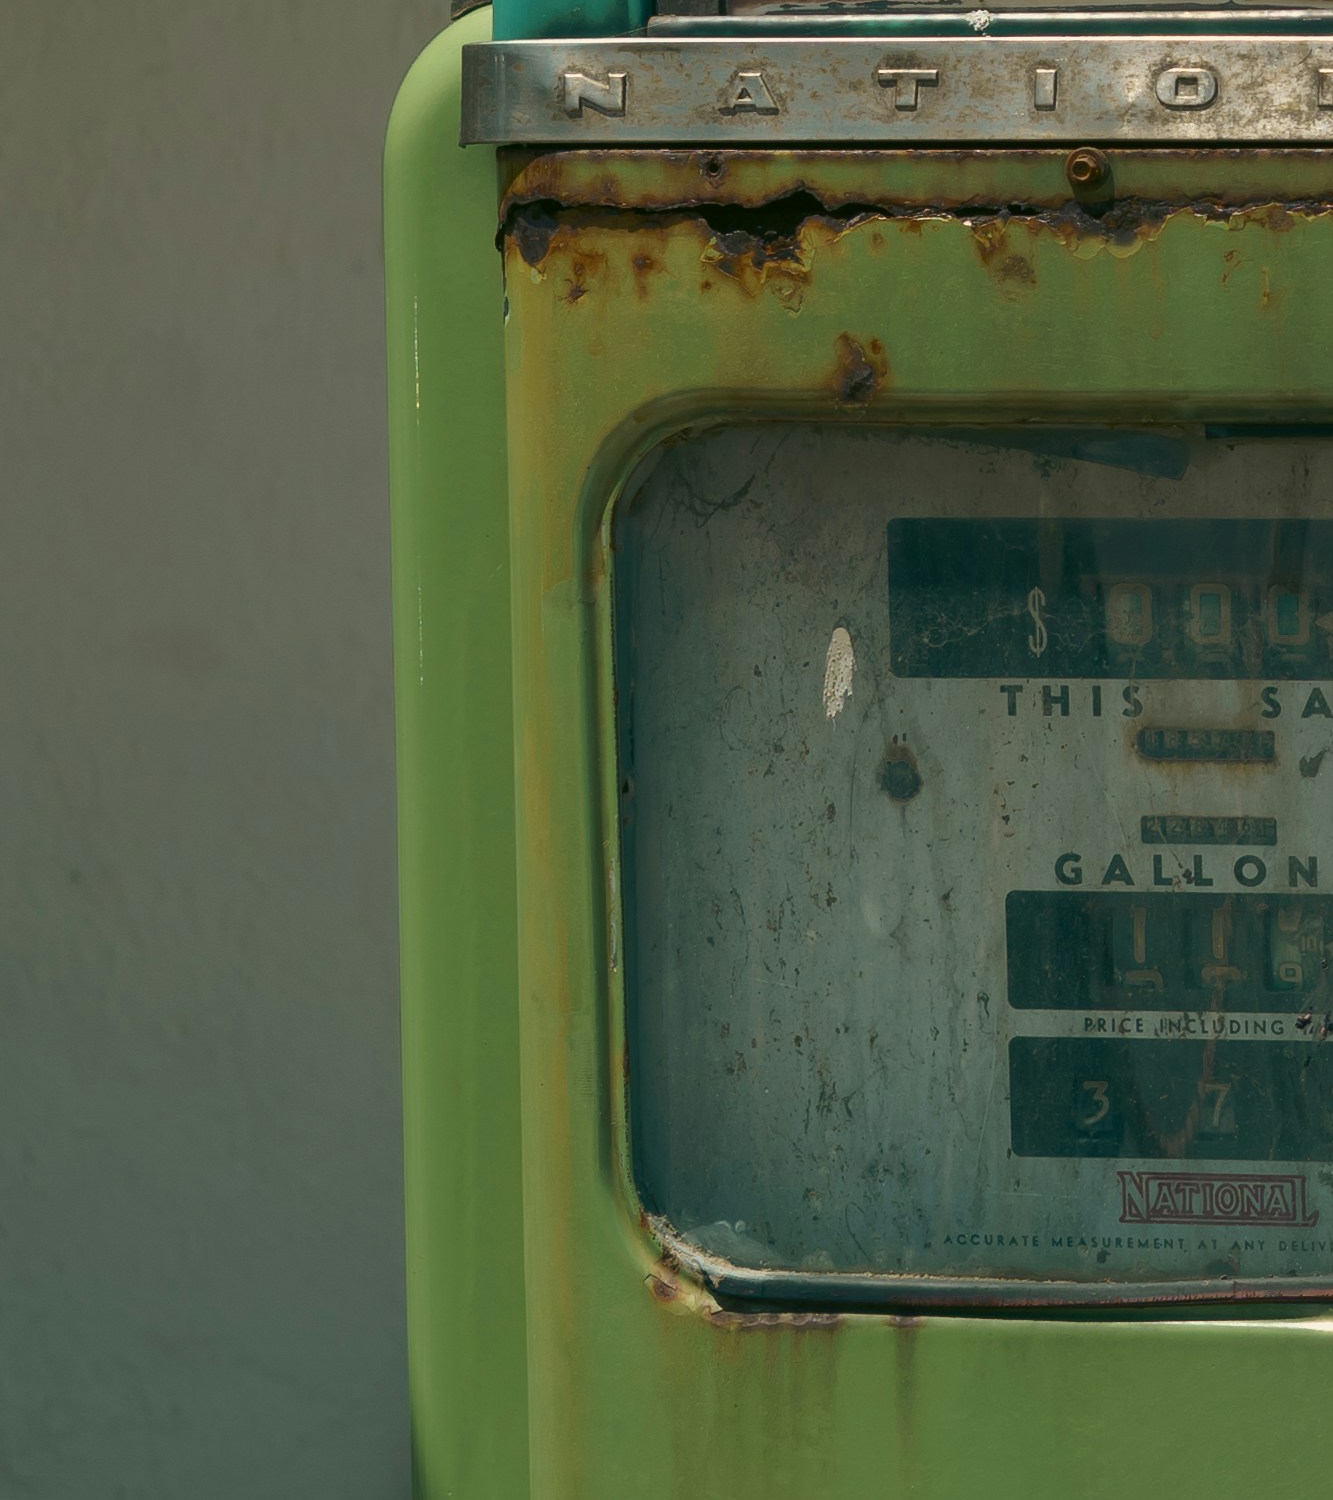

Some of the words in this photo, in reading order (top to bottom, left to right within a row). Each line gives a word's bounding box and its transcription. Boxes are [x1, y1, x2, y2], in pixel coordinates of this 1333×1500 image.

[1000, 684, 1145, 718] THIS
[1083, 1017, 1145, 1035] PRICE
[1159, 1018, 1286, 1037] INCLUDING
[1117, 1171, 1321, 1228] NATIONAL
[943, 1233, 1040, 1248] ACCURATE
[1051, 1235, 1186, 1250] MEASUREMENT
[1197, 1238, 1218, 1251] AT
[1231, 1239, 1266, 1252] ANY
